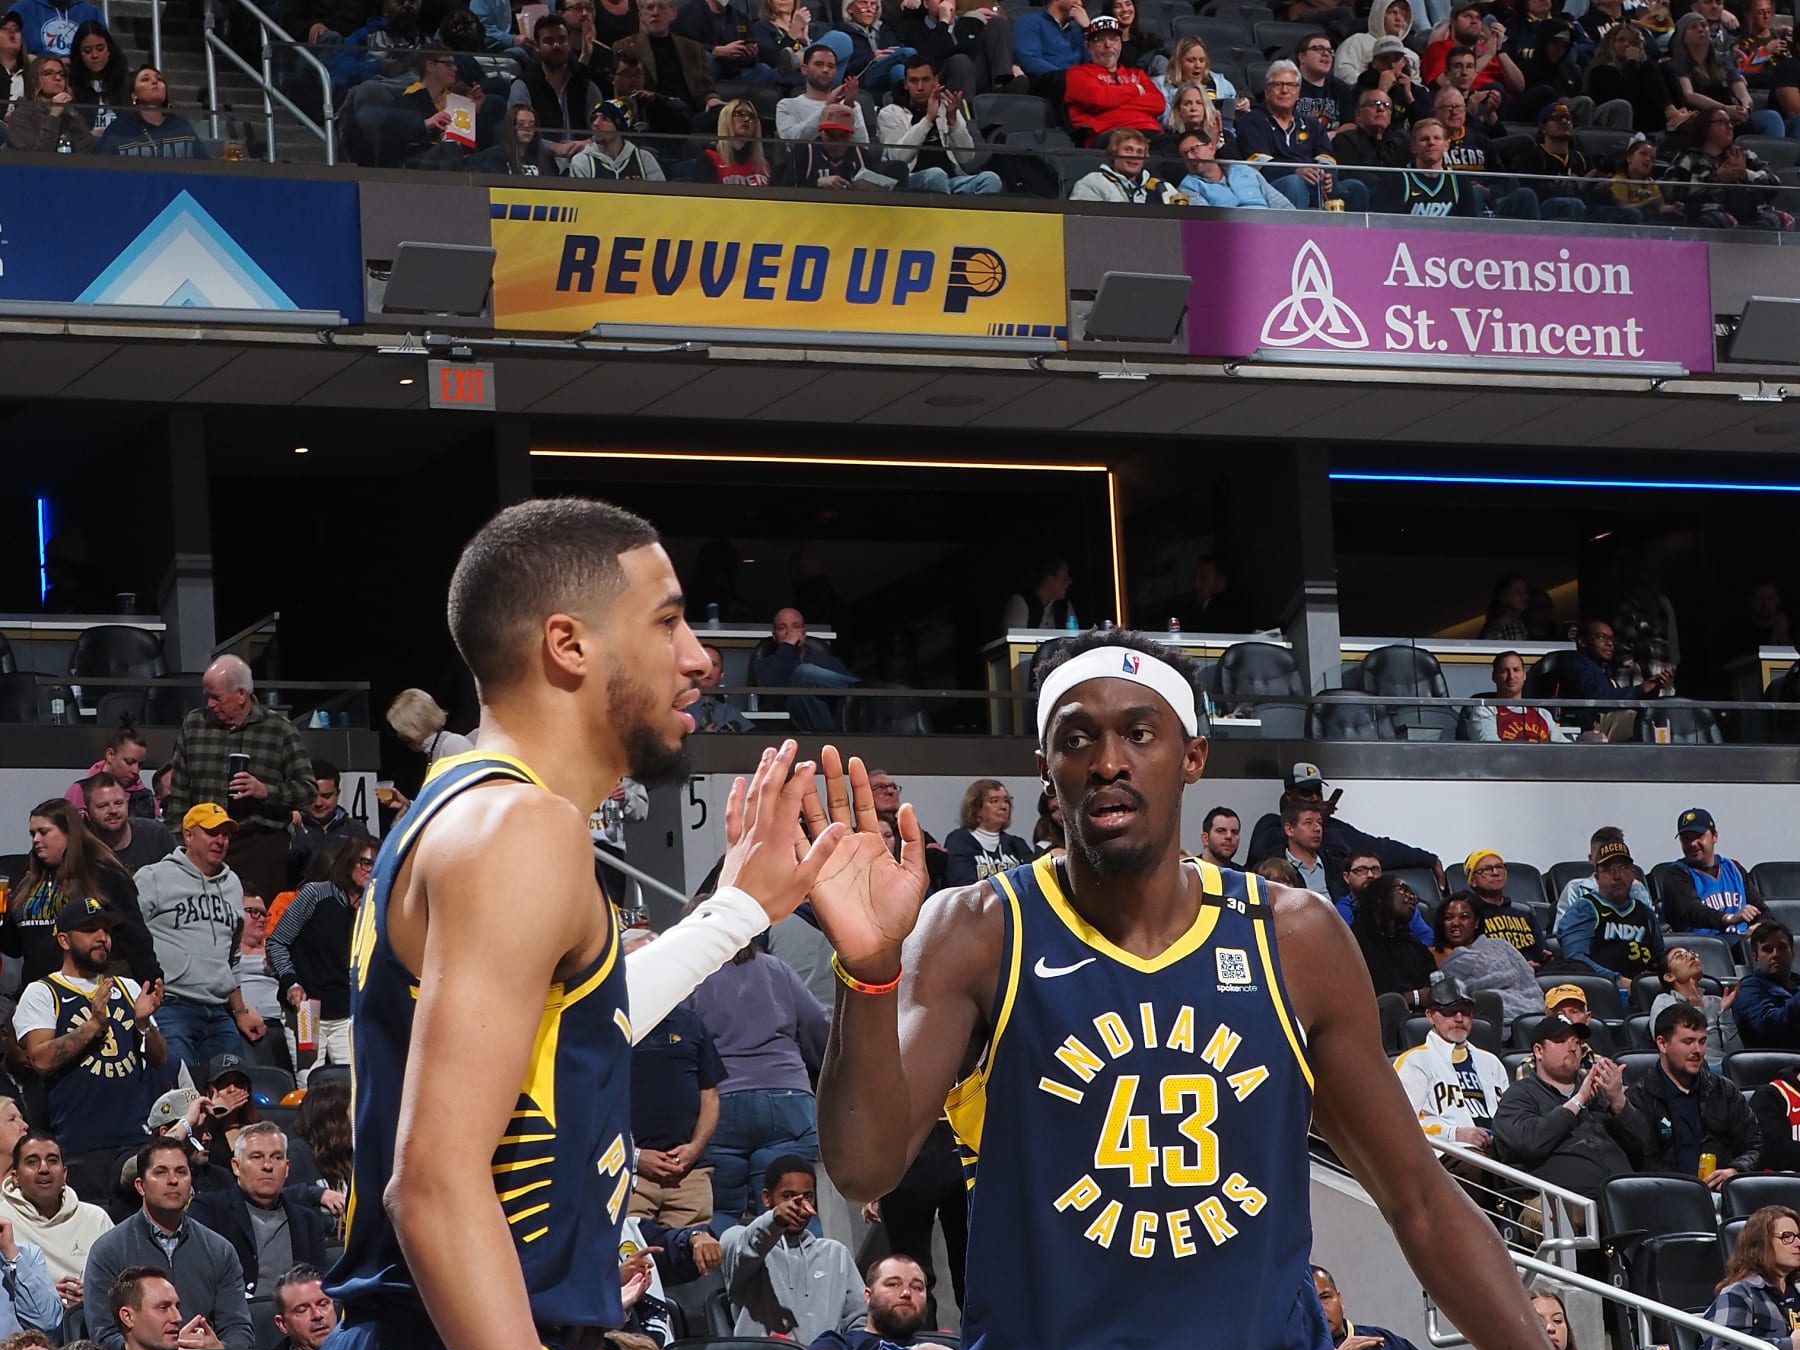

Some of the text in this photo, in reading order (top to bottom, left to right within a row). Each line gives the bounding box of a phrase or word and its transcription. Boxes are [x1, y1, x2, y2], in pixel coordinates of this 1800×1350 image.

[1443, 147, 1485, 165] ACERS
[556, 235, 935, 306] REVVED UP
[1383, 242, 1634, 295] Ascension
[1385, 304, 1645, 358] St. Vincent
[441, 367, 484, 404] EXIT
[352, 776, 370, 823] 4
[689, 776, 707, 830] 5
[1226, 897, 1246, 915] 30
[1701, 890, 1743, 910] HUNDE
[1603, 922, 1645, 943] INDY
[1628, 942, 1651, 964] 33
[1216, 984, 1258, 993] spokenote
[67, 1006, 135, 1033] INDNA
[1038, 1002, 1270, 1104] INDIANA
[1094, 1074, 1220, 1188] 43
[1053, 1172, 1267, 1259] PACERS
